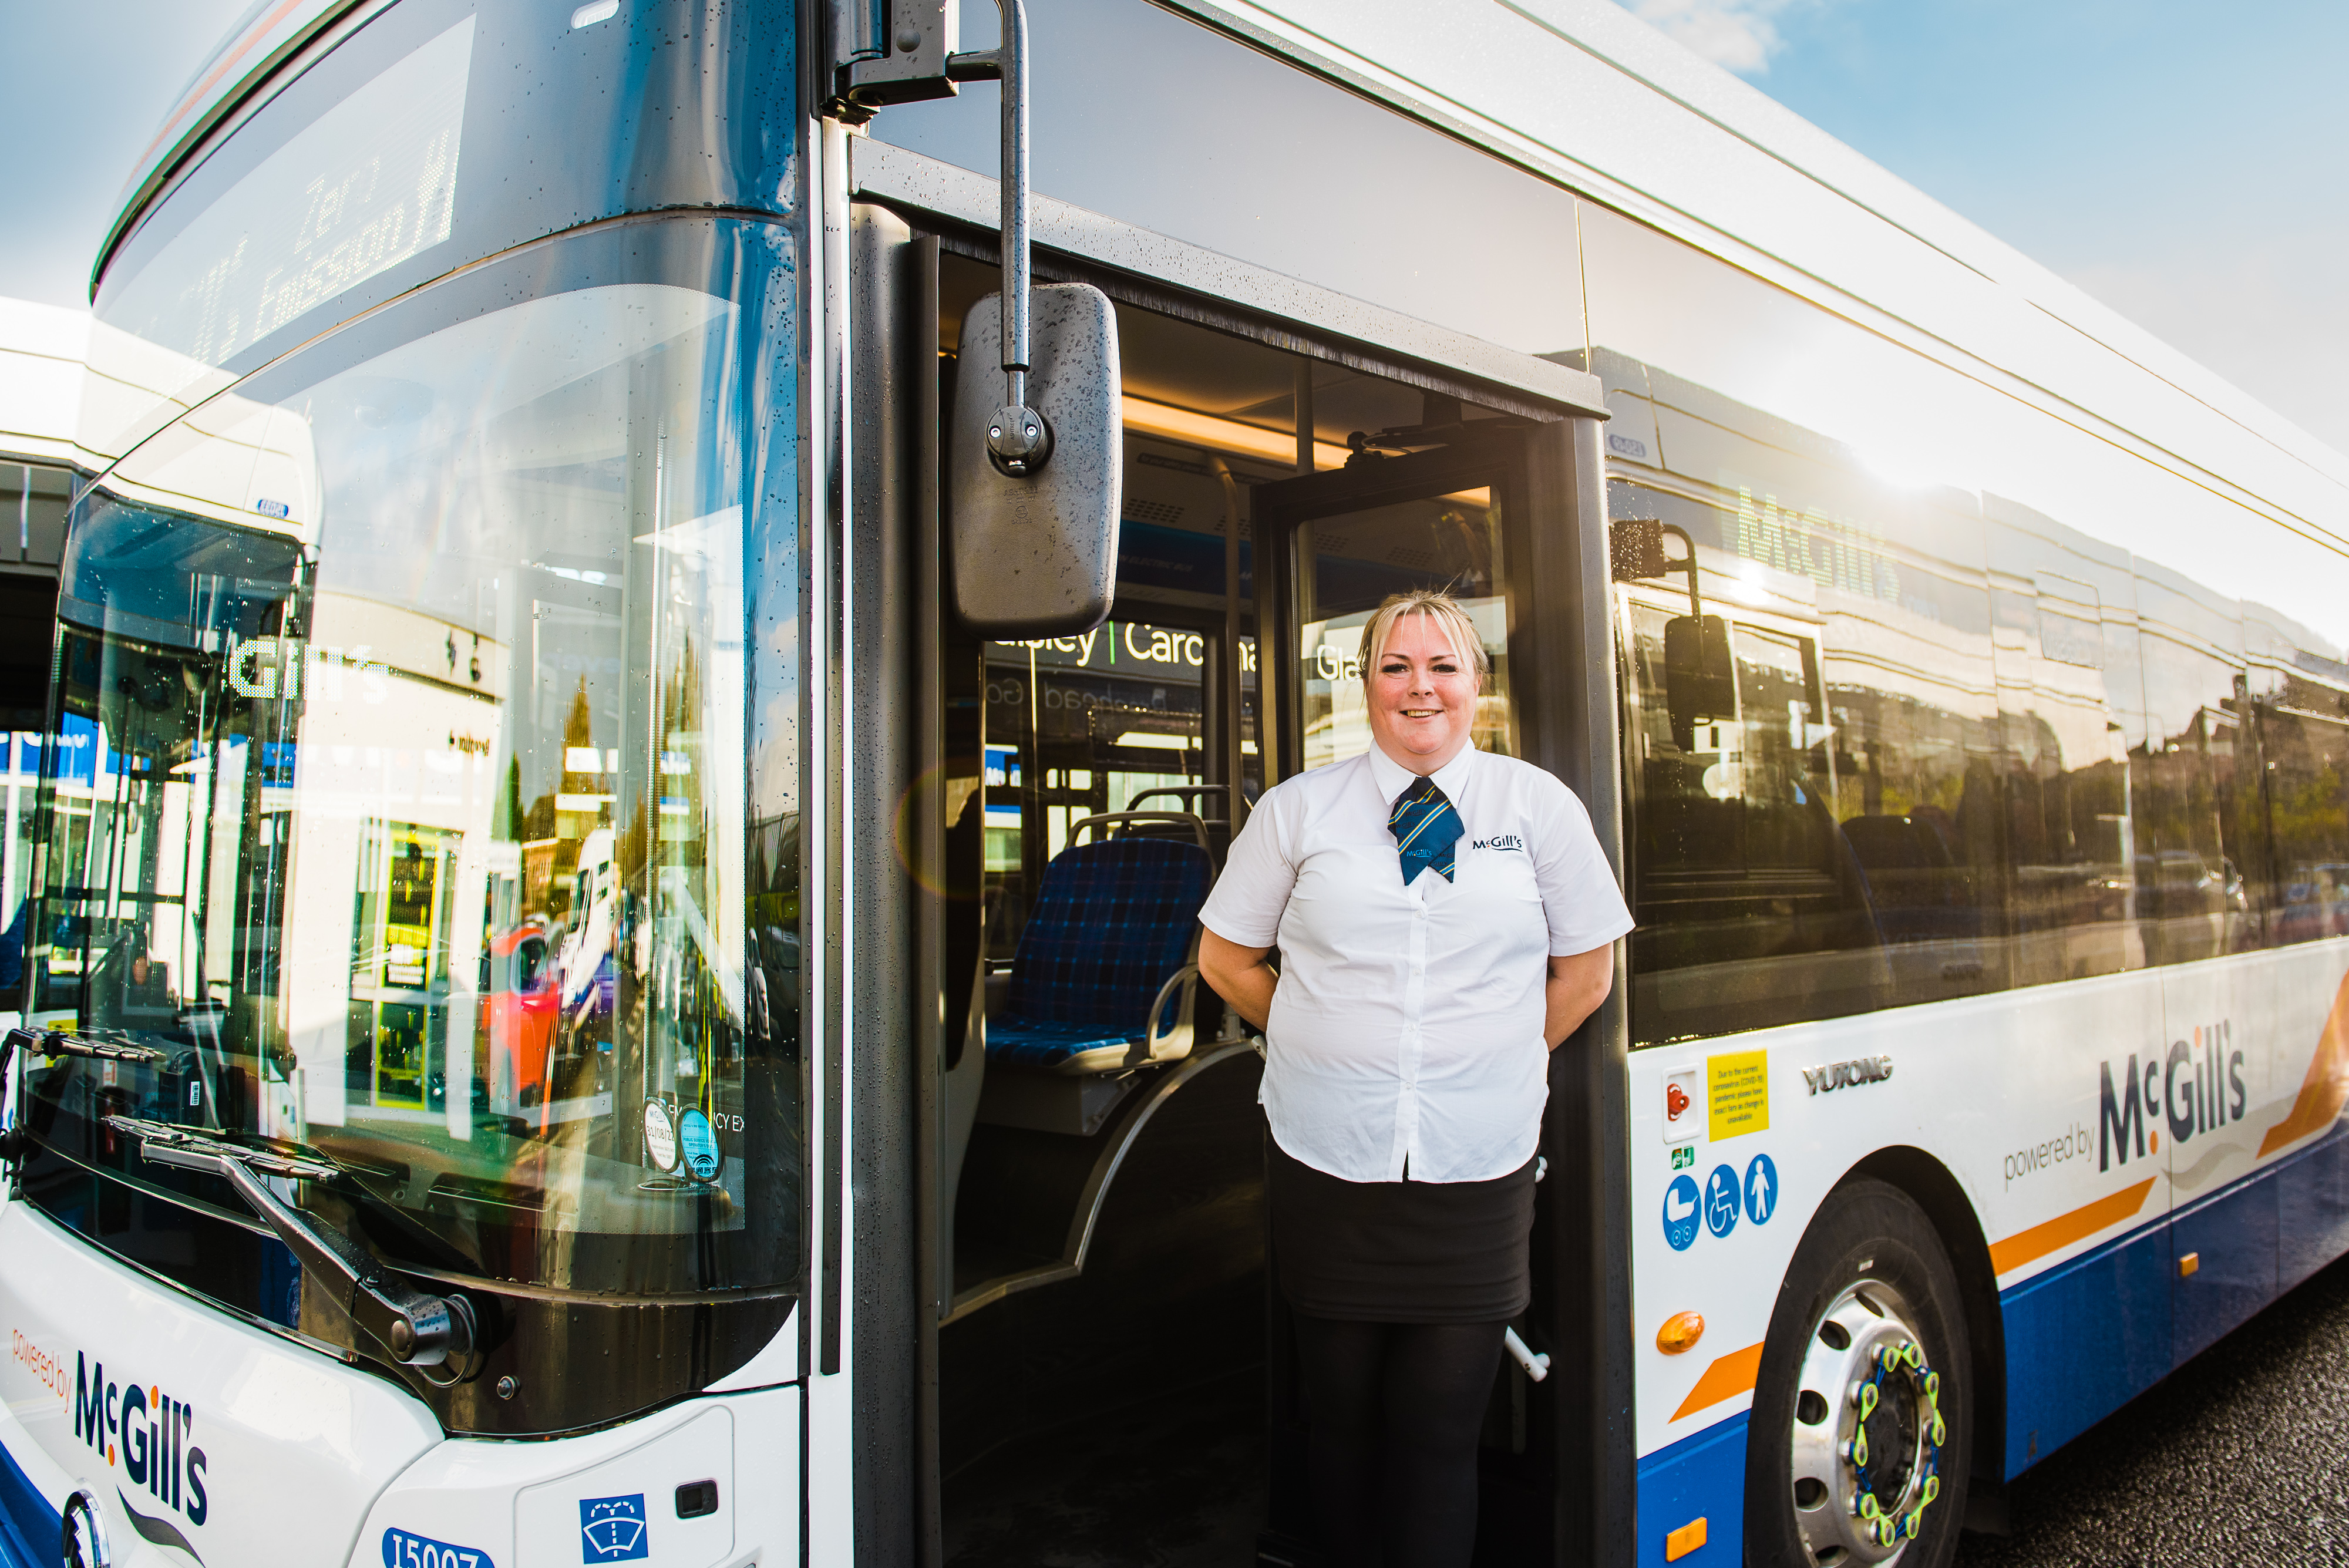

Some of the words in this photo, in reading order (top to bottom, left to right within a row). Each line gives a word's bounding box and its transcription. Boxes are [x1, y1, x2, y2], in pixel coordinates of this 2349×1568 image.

[1737, 484, 1901, 603] McGill's
[1472, 835, 1522, 850] McGill's
[1406, 849, 1432, 857] McGill's
[1718, 1071, 1727, 1079] Due
[1742, 1065, 1759, 1075] current
[1802, 1056, 1893, 1096] YUTONG
[1713, 1081, 1740, 1092] coronavirus
[1738, 1091, 1752, 1101] please
[1714, 1107, 1727, 1115] exact
[1728, 1104, 1736, 1112] fare
[1744, 1101, 1759, 1111] change
[2004, 1123, 2074, 1193] powered
[2078, 1122, 2095, 1163] by
[2099, 1018, 2247, 1174] McGill's
[1728, 1112, 1752, 1125] unavailable
[13, 1327, 55, 1390] powered
[56, 1354, 72, 1414] by
[75, 1349, 207, 1526] McGill's
